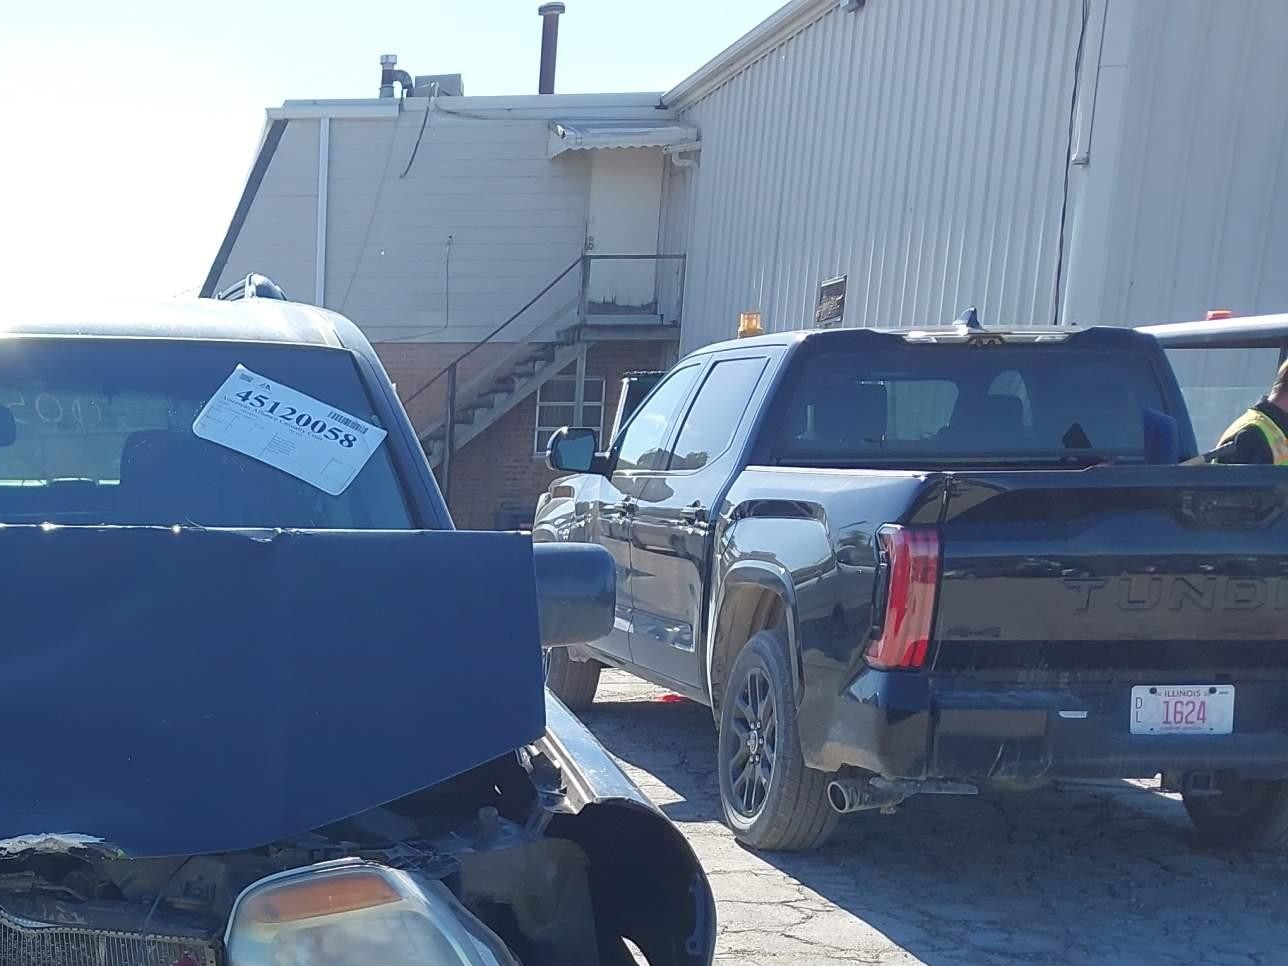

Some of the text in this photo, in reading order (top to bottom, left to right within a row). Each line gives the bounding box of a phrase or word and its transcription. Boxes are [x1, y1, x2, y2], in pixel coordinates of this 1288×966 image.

[235, 389, 358, 449] 45120058
[1063, 577, 1288, 612] TUND
[1164, 689, 1201, 698] ILLINOIS
[1161, 700, 1208, 724] 1624
